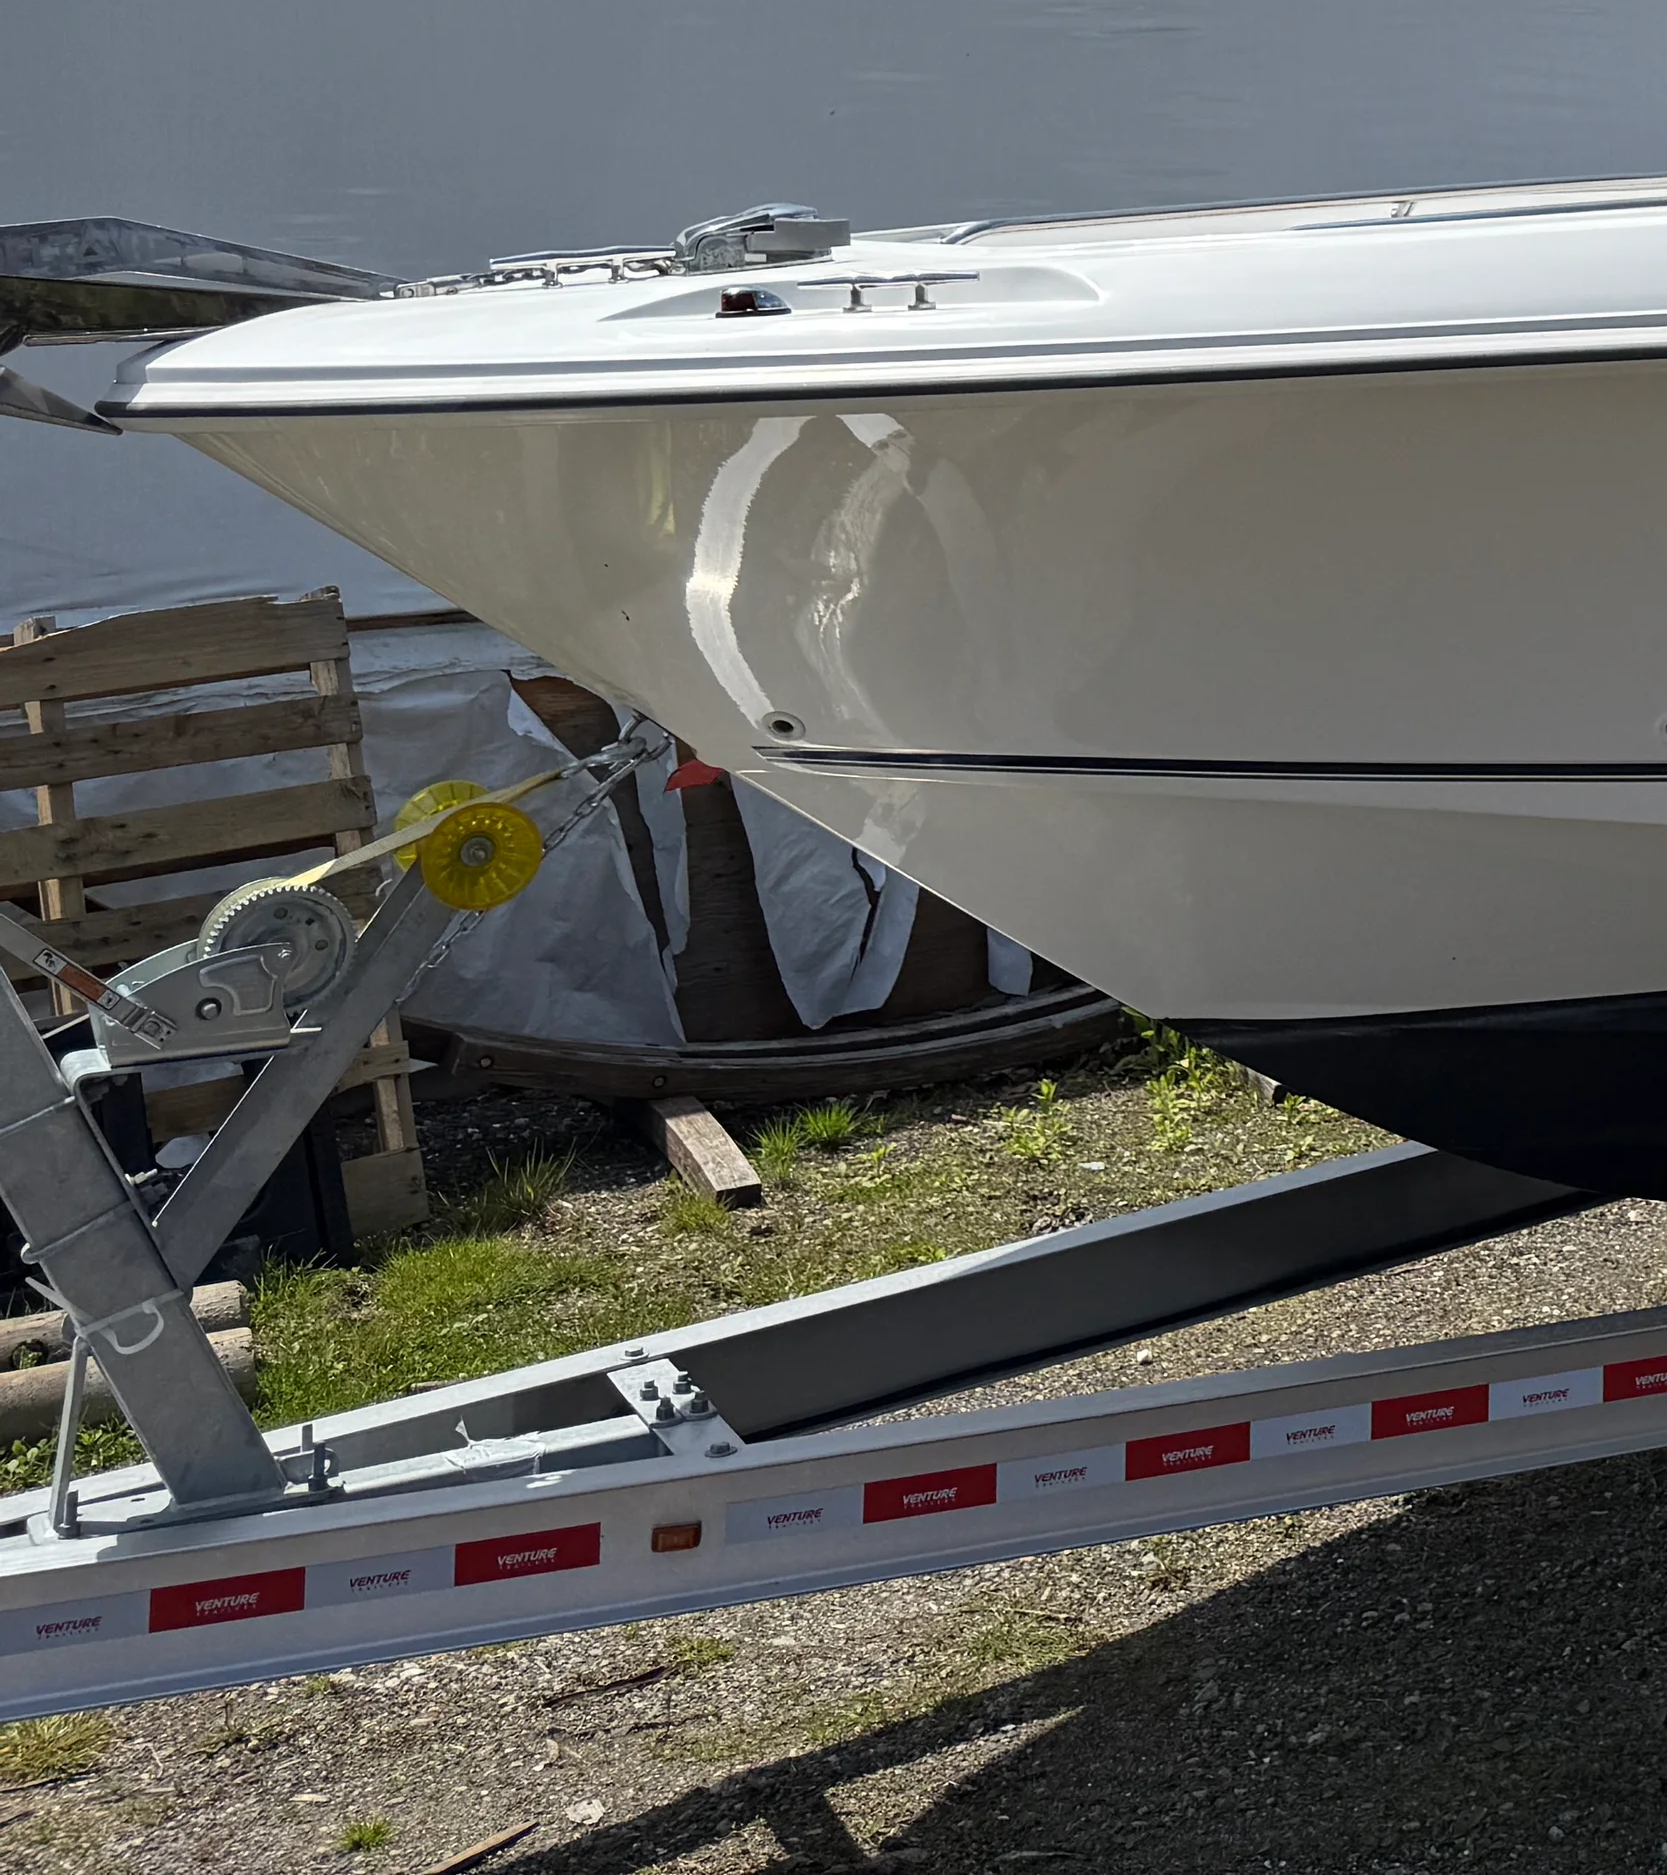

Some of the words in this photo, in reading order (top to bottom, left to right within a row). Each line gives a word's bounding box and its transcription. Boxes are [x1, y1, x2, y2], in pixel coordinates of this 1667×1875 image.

[1522, 1388, 1570, 1405] VENTURE
[1405, 1406, 1454, 1423] VENTURE
[1285, 1425, 1336, 1442] VENTURE
[1161, 1445, 1215, 1463] VENTURE
[1034, 1466, 1088, 1484] VENTURE
[903, 1487, 958, 1505] VENTURE
[766, 1508, 823, 1526] VENTURE
[498, 1547, 557, 1565] VENTURE
[350, 1570, 412, 1588] VENTURE
[195, 1592, 260, 1612] VENTURE
[36, 1616, 103, 1636] VENTURE
